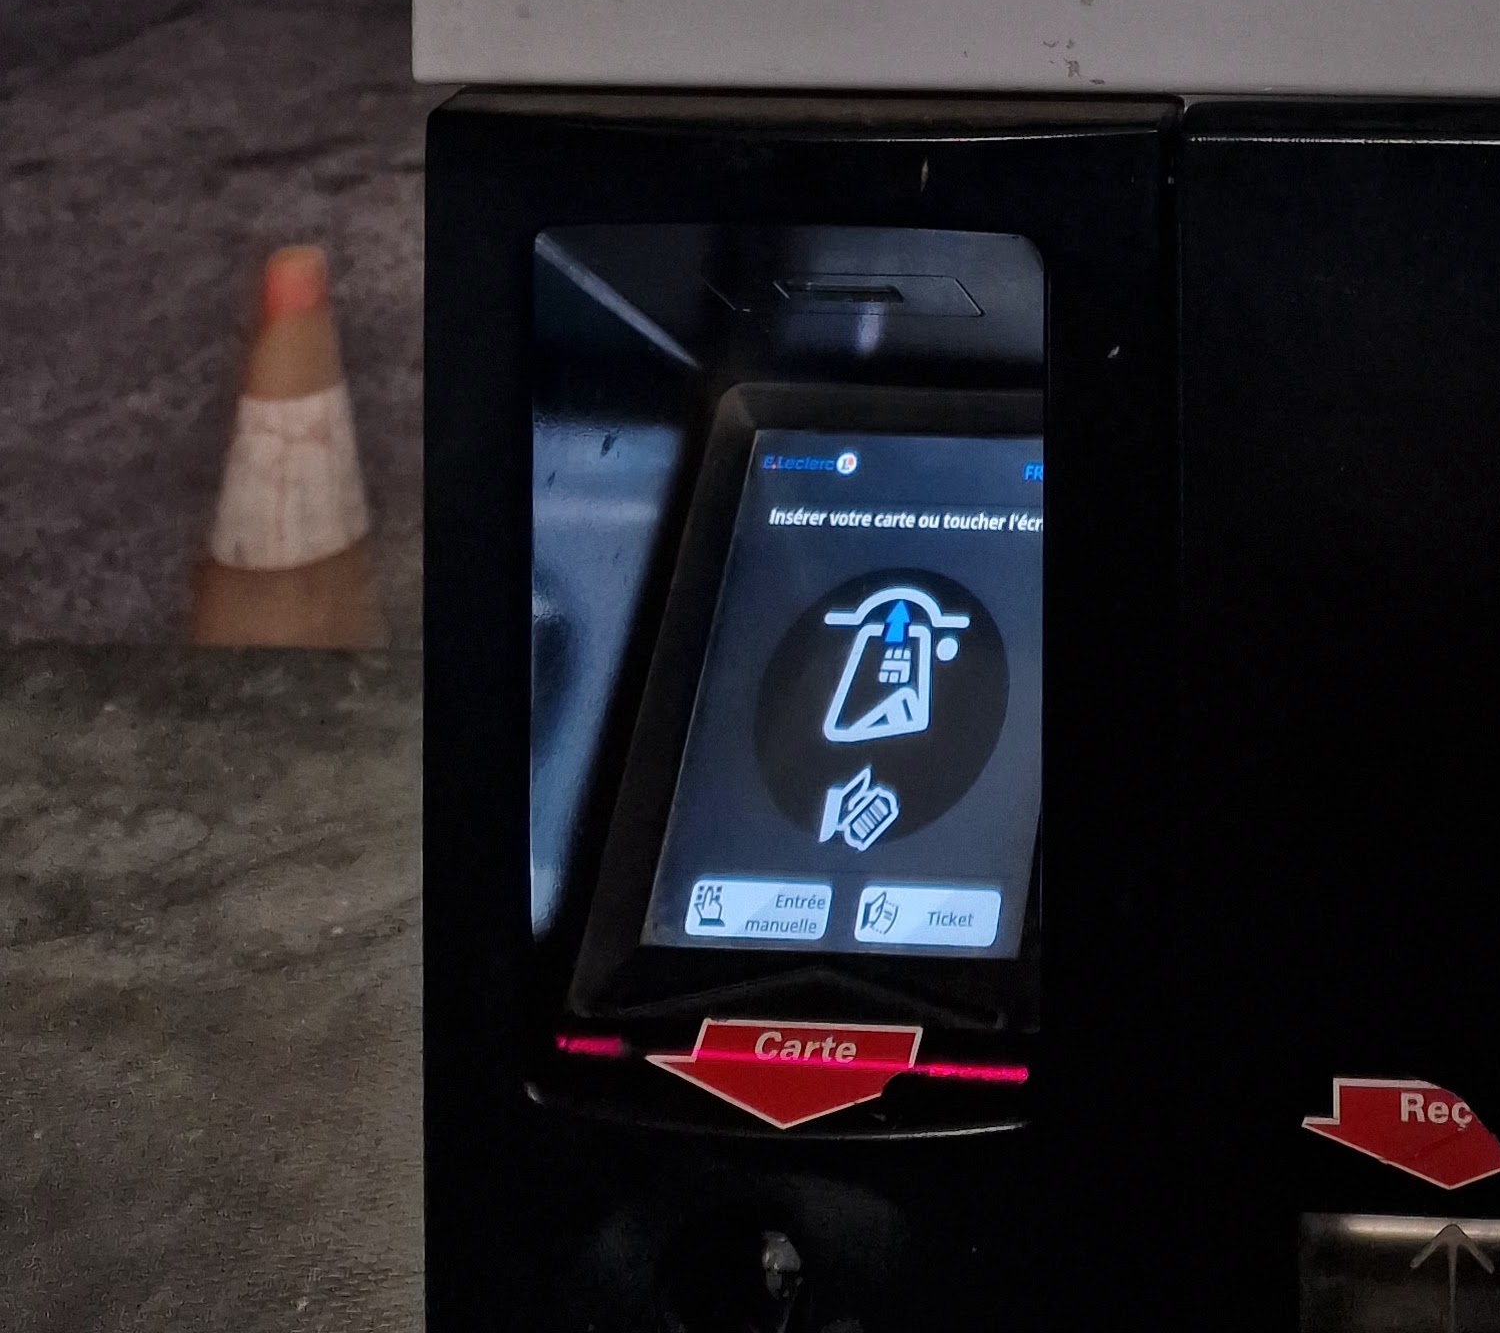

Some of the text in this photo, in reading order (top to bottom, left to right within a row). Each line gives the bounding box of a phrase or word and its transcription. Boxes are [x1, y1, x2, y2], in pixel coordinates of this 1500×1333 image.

[769, 507, 826, 528] Insérer
[829, 510, 872, 528] votre
[874, 512, 914, 529] carte
[918, 513, 940, 530] ou
[943, 509, 1006, 531] toucher
[774, 893, 826, 912] Entrée
[744, 917, 817, 935] manuelle
[926, 910, 974, 929] Ticket
[754, 1031, 857, 1064] Carte
